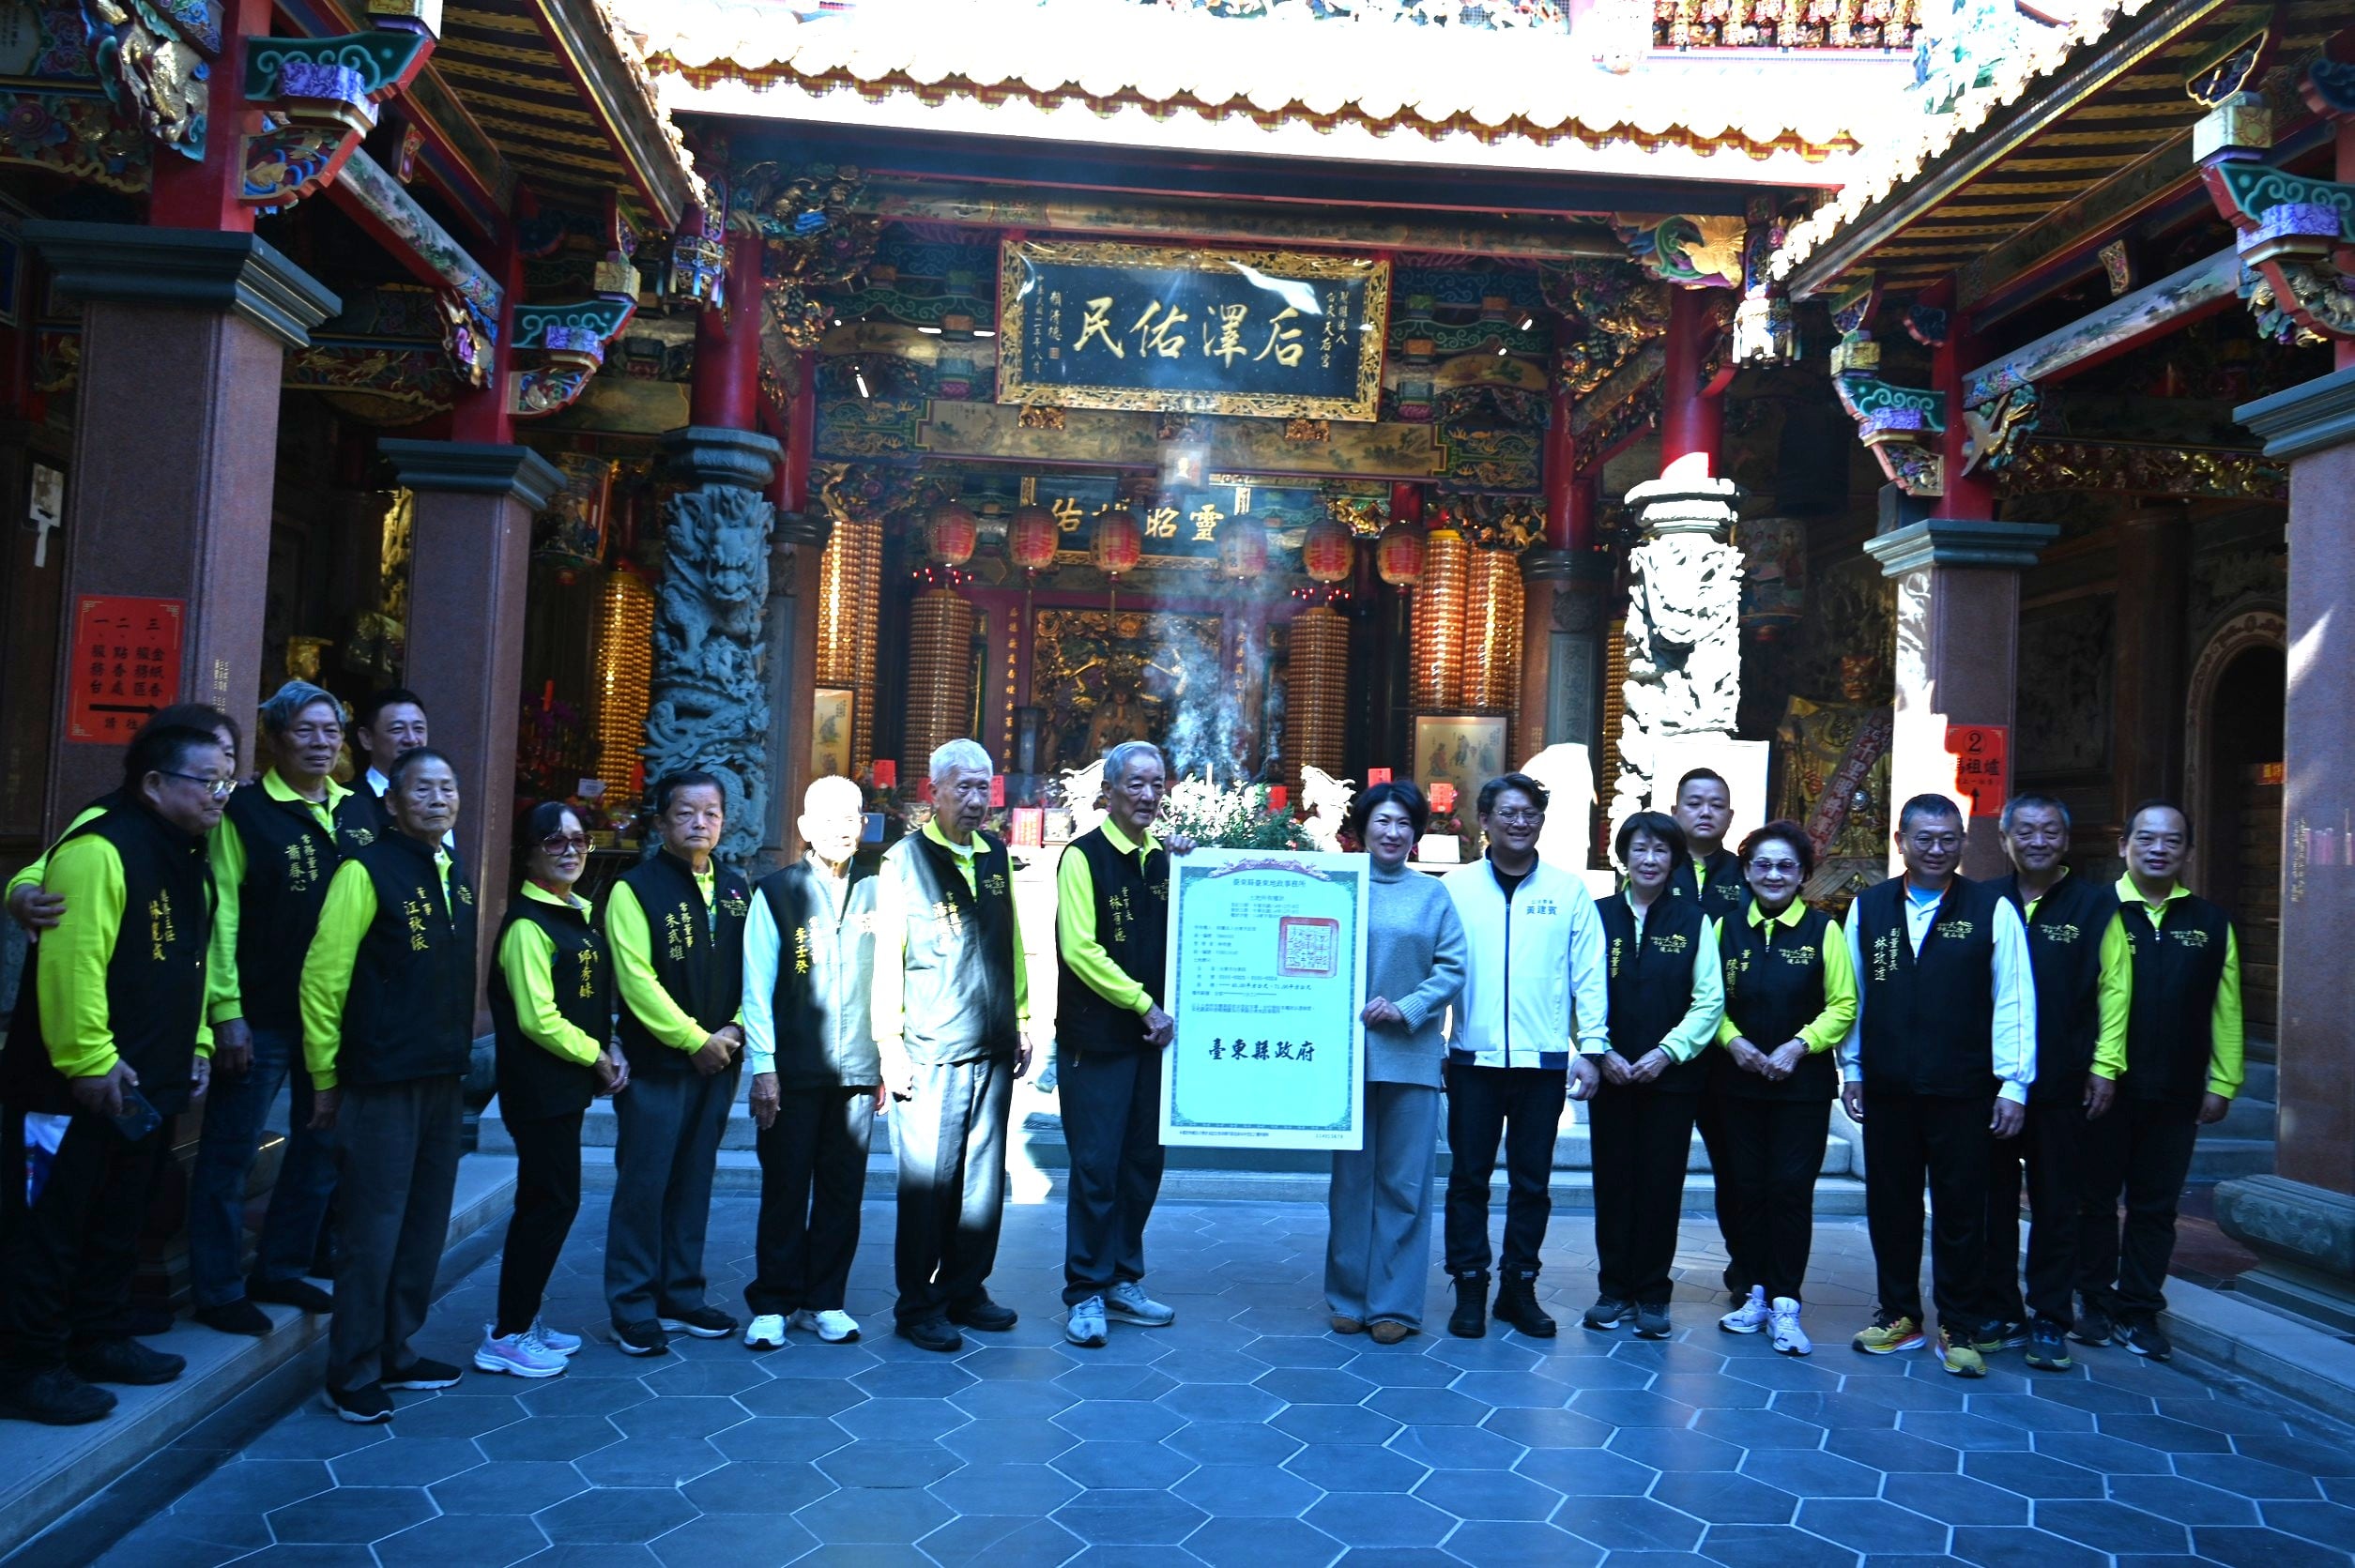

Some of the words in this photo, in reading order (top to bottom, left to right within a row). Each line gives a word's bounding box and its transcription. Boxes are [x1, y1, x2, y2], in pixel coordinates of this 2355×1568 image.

[1048, 290, 1063, 341] 賴清德
[1073, 296, 1304, 368] 后澤佑民
[1320, 292, 1336, 368] 台東天后宮
[1336, 291, 1349, 344] 財團法人
[1208, 1037, 1315, 1062] 臺東縣政府
